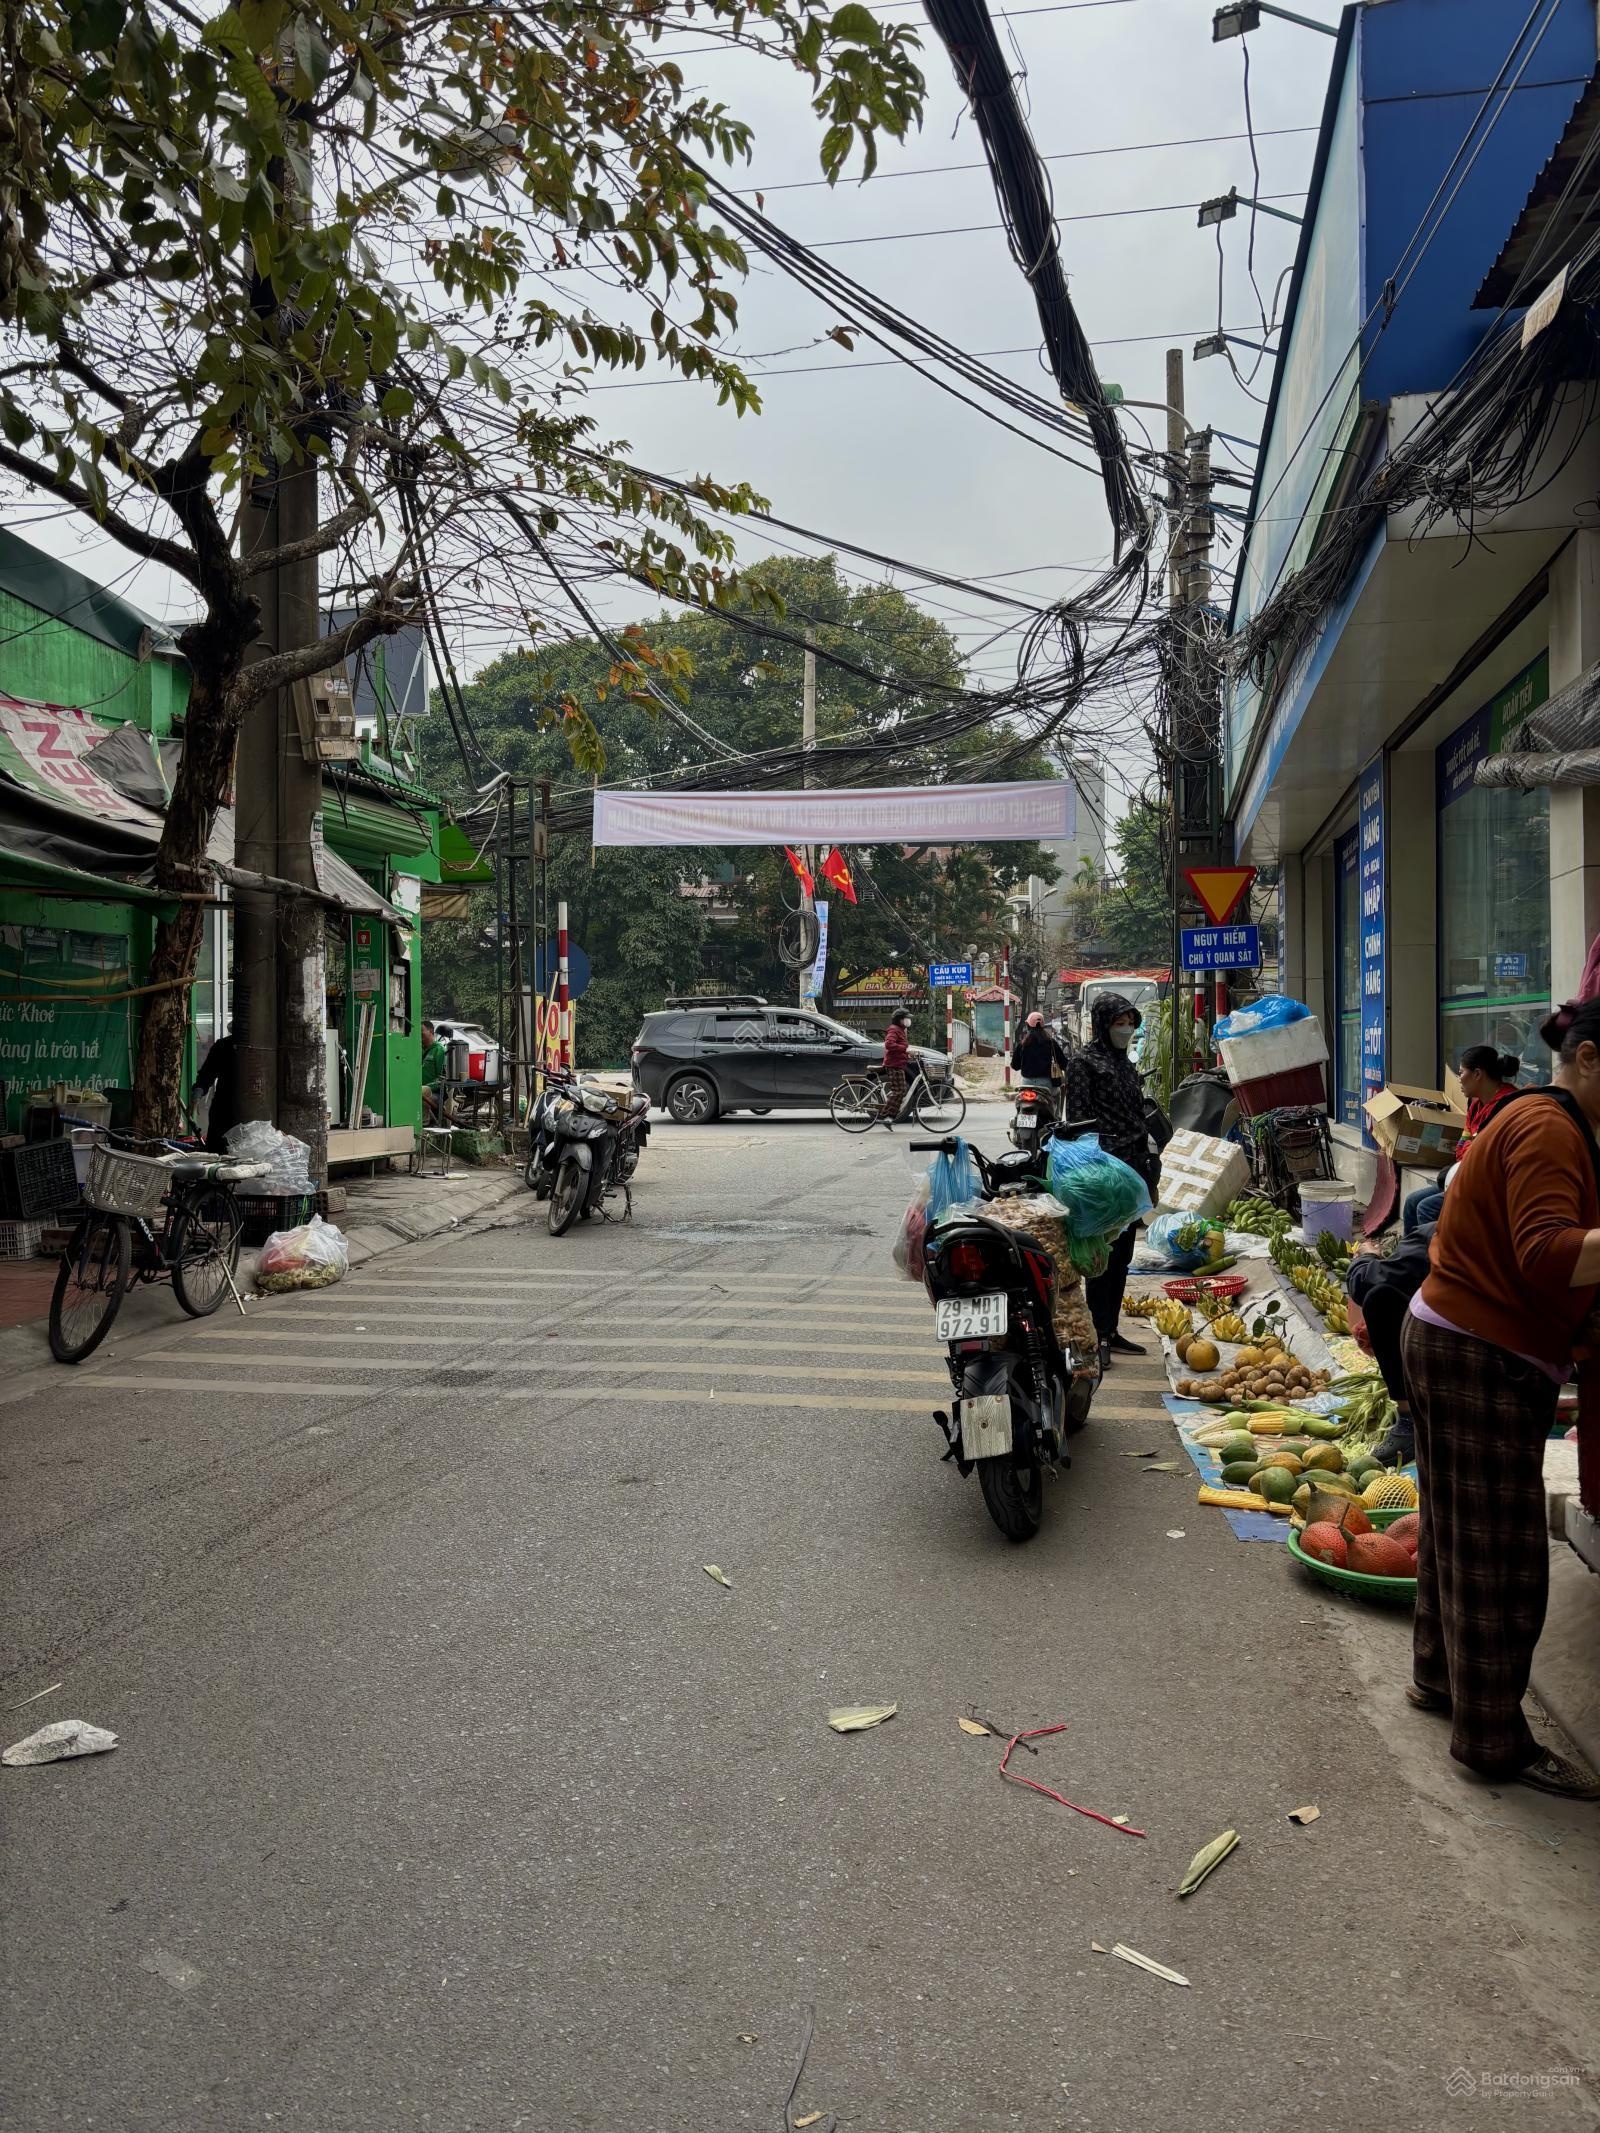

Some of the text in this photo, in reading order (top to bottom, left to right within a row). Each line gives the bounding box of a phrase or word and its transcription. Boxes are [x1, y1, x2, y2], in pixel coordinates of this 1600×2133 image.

[1364, 880, 1381, 923] NHẬP
[1193, 927, 1247, 947] NGUY HIỂM
[1188, 948, 1252, 965] CHÚ Ý QUAN SÁT
[35, 1038, 49, 1059] là
[51, 1040, 78, 1059] trên
[941, 1315, 999, 1337] 972.91
